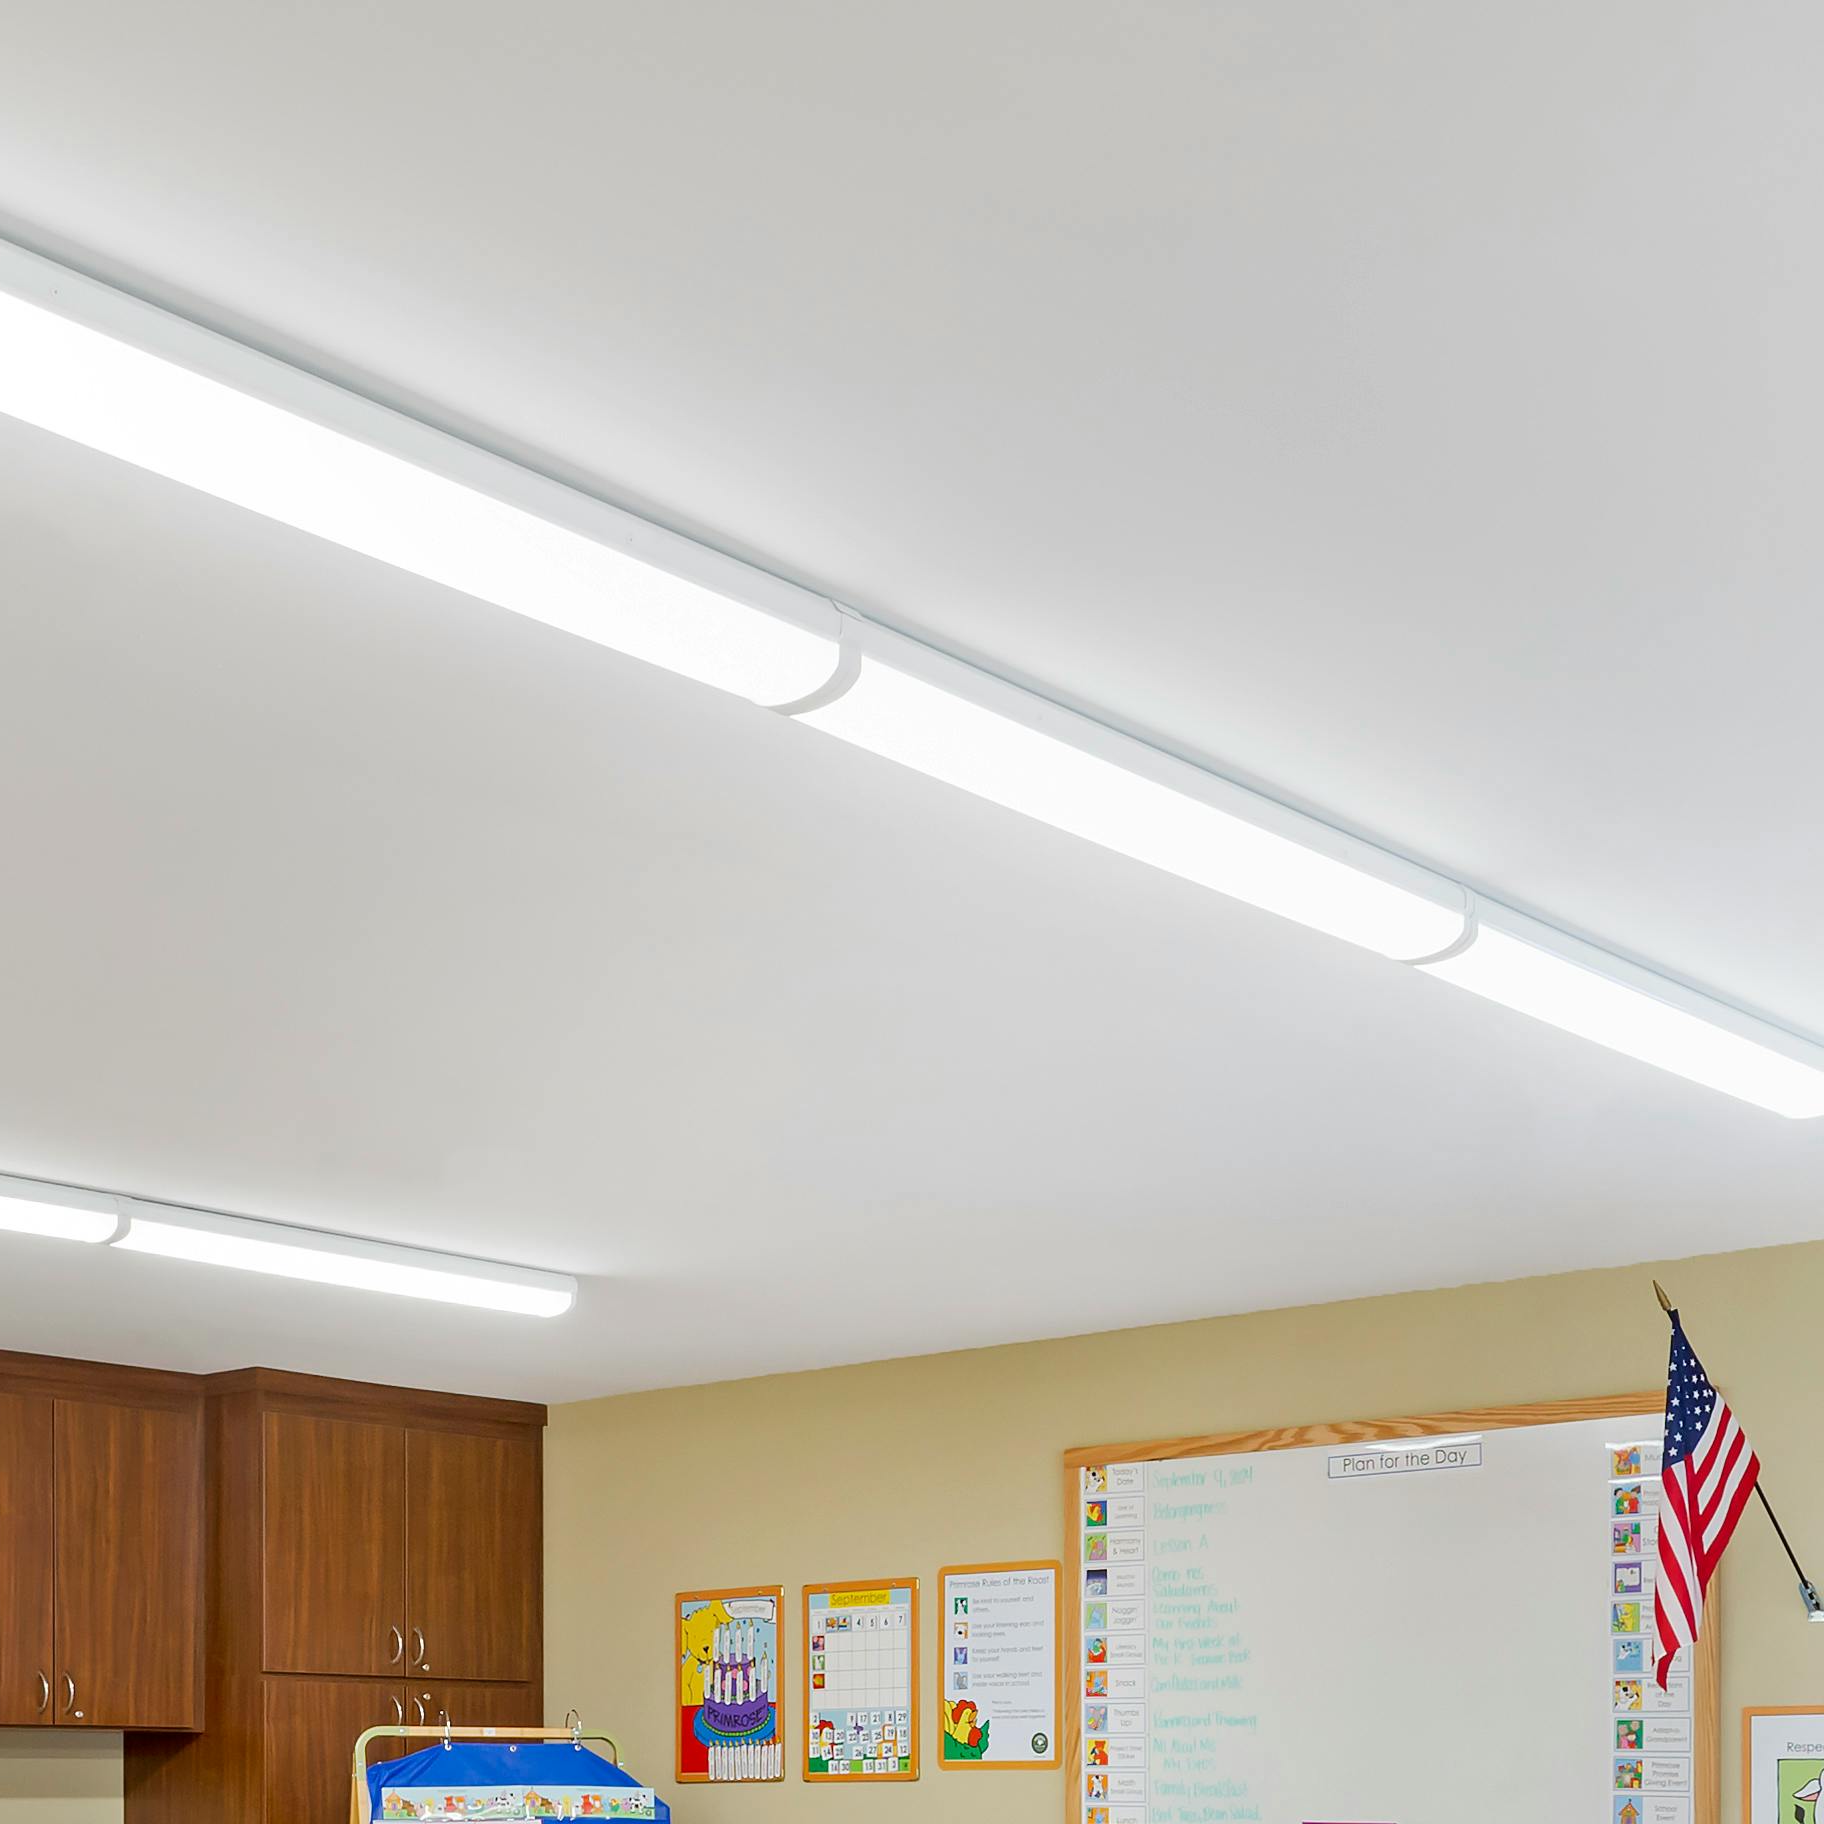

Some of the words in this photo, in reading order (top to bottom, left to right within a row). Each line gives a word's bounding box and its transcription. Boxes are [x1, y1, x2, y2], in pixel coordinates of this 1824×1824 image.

[1343, 1458, 1375, 1473] Plan
[1380, 1454, 1400, 1469] for
[1406, 1452, 1430, 1466] the
[1436, 1449, 1468, 1465] Day
[982, 1578, 1002, 1587] Rules
[1003, 1577, 1011, 1586] of
[1013, 1576, 1026, 1585] the
[1028, 1575, 1050, 1585] Roost
[831, 1591, 887, 1606] September
[1115, 1679, 1137, 1687] Snack
[706, 1705, 764, 1729] PRIMROSE
[898, 1713, 907, 1722] 29
[848, 1733, 857, 1742] 22
